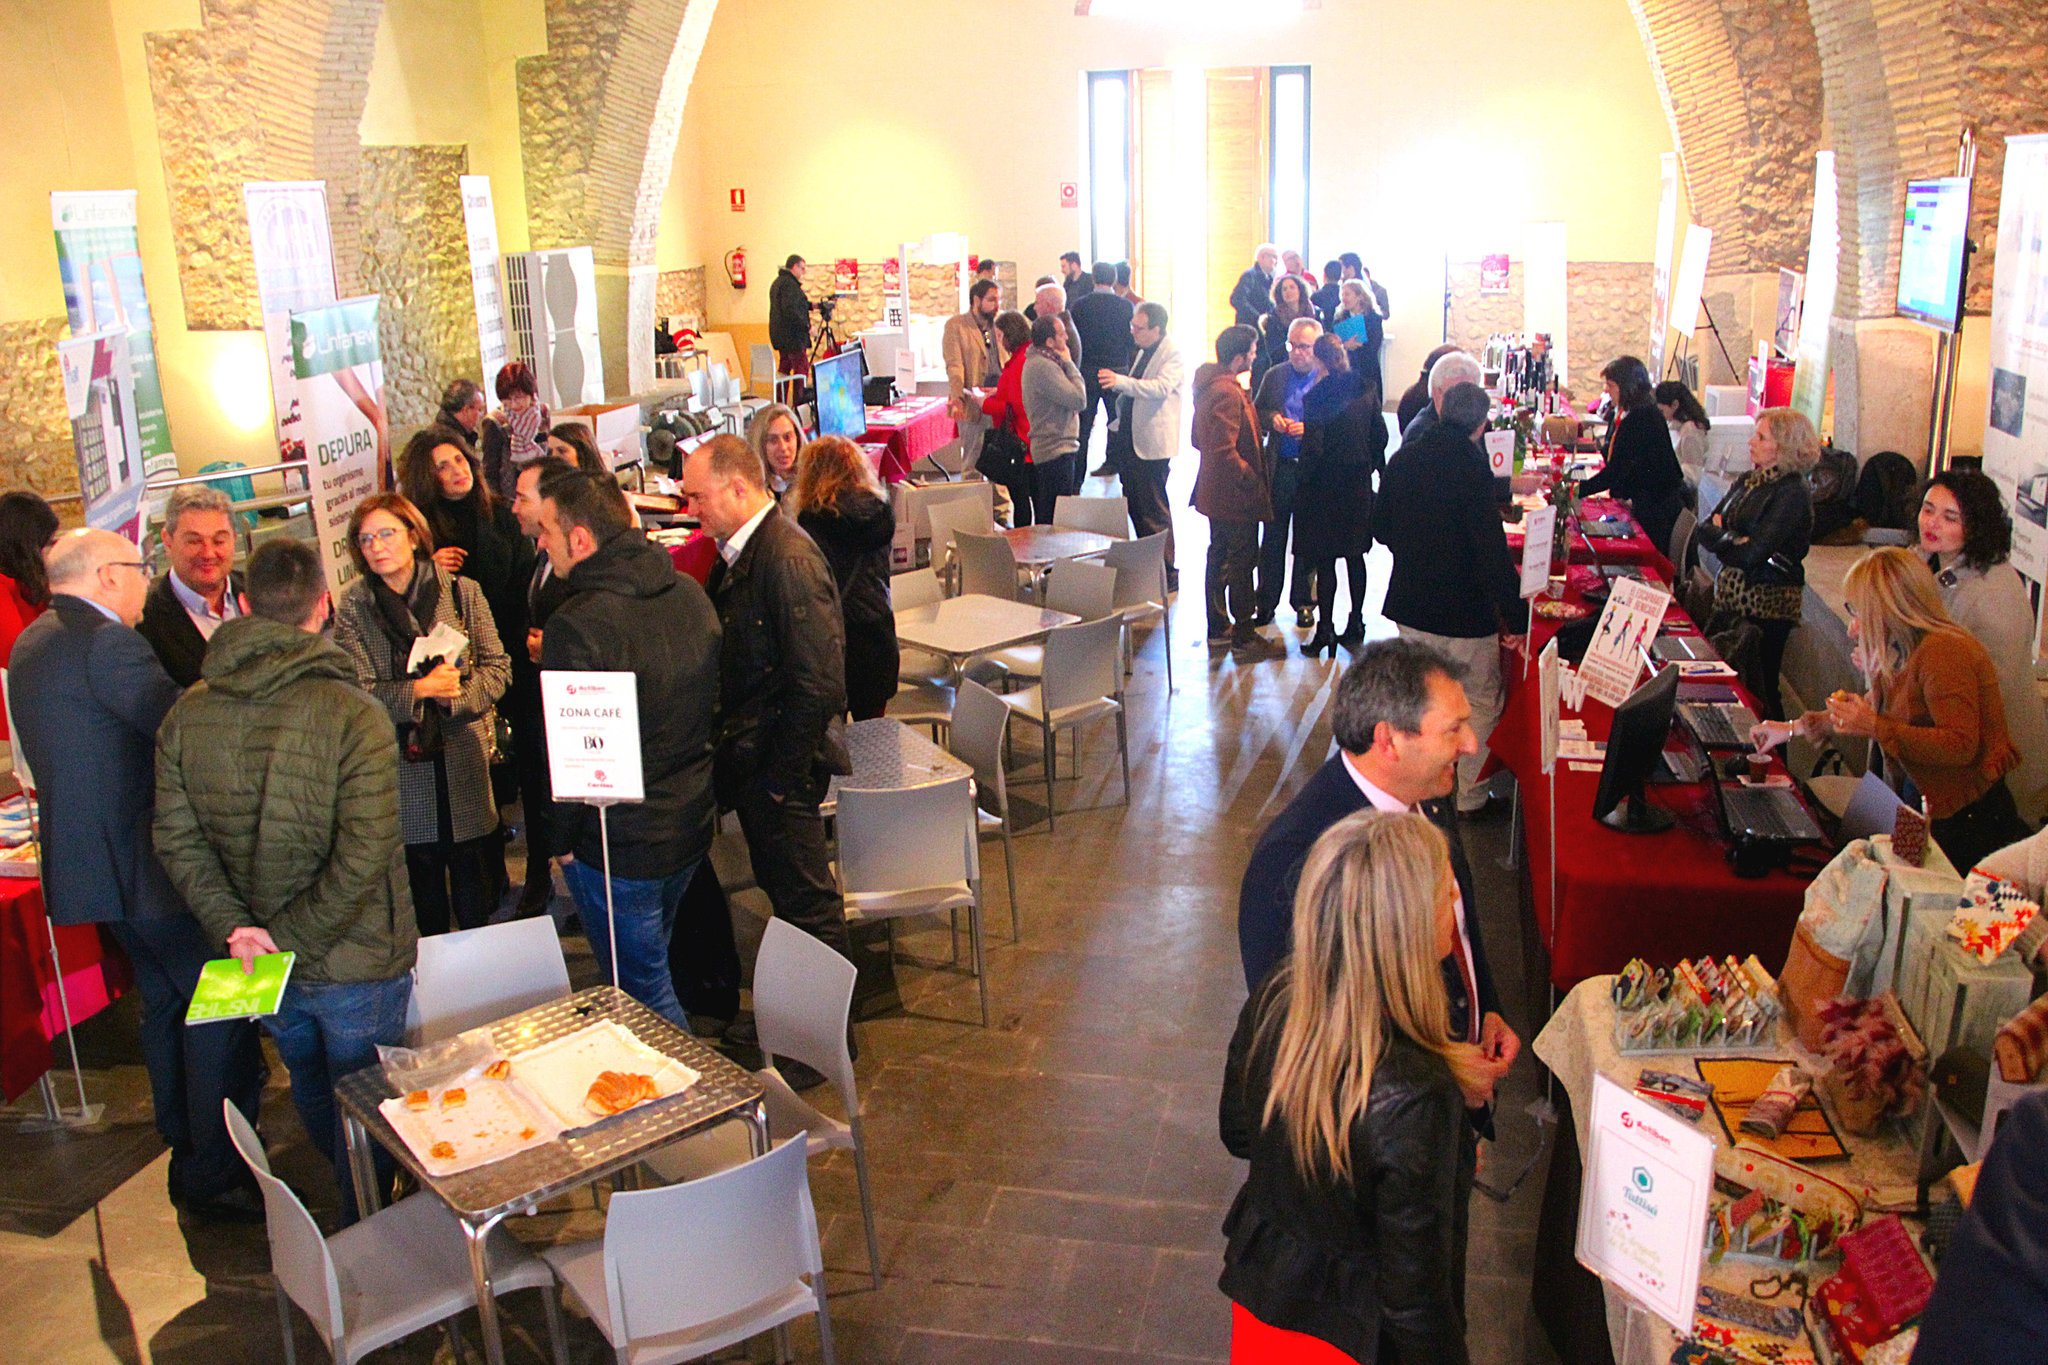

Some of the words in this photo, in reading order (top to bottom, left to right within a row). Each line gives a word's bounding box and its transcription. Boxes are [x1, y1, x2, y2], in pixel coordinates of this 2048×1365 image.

[317, 429, 373, 466] DEPURA
[322, 479, 332, 490] tu
[333, 467, 364, 488] organismo
[326, 493, 348, 512] gracias
[559, 708, 591, 718] ZONA
[593, 707, 621, 718] CAFÉ
